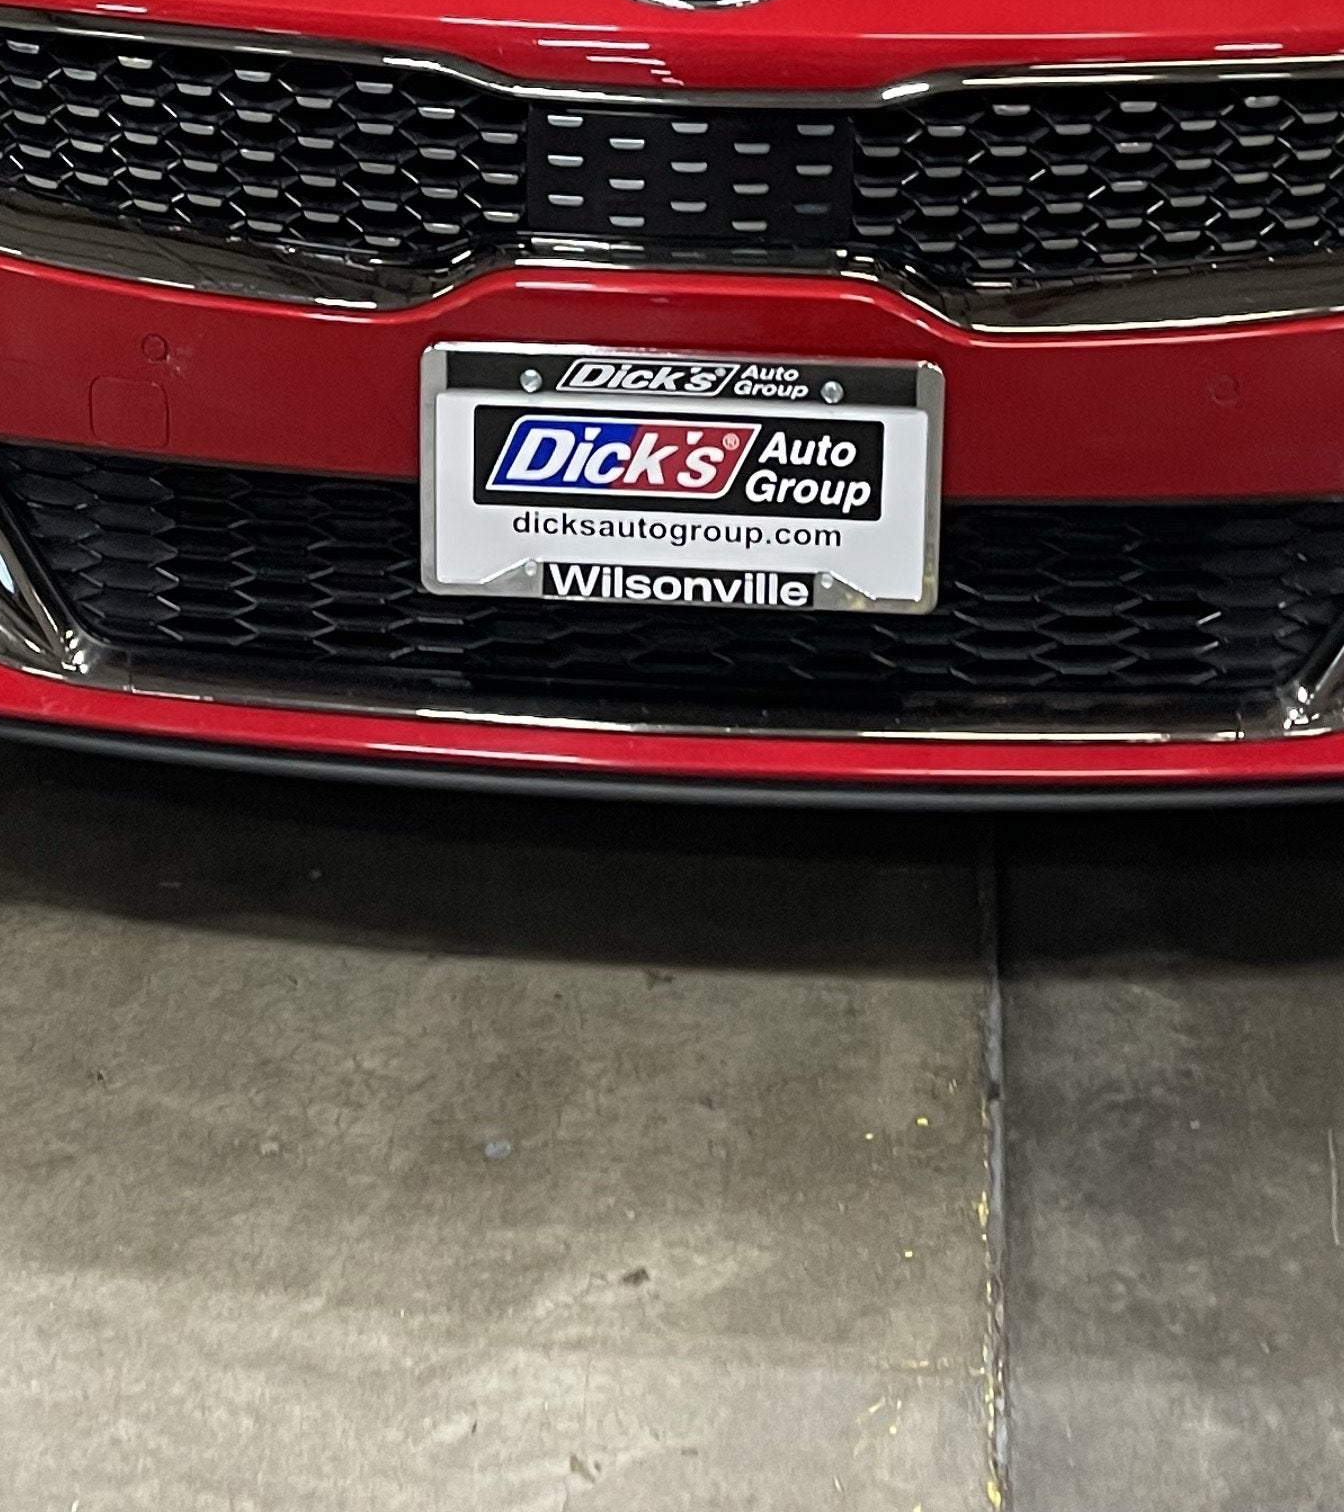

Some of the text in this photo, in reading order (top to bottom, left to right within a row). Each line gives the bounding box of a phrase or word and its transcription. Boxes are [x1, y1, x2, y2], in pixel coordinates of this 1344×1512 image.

[733, 380, 809, 400] Group
[740, 365, 800, 382] Auto
[758, 431, 856, 468] Auto
[744, 469, 871, 514] Group
[512, 511, 842, 549] dicksautogroup.com
[549, 563, 809, 607] Wilsonville
